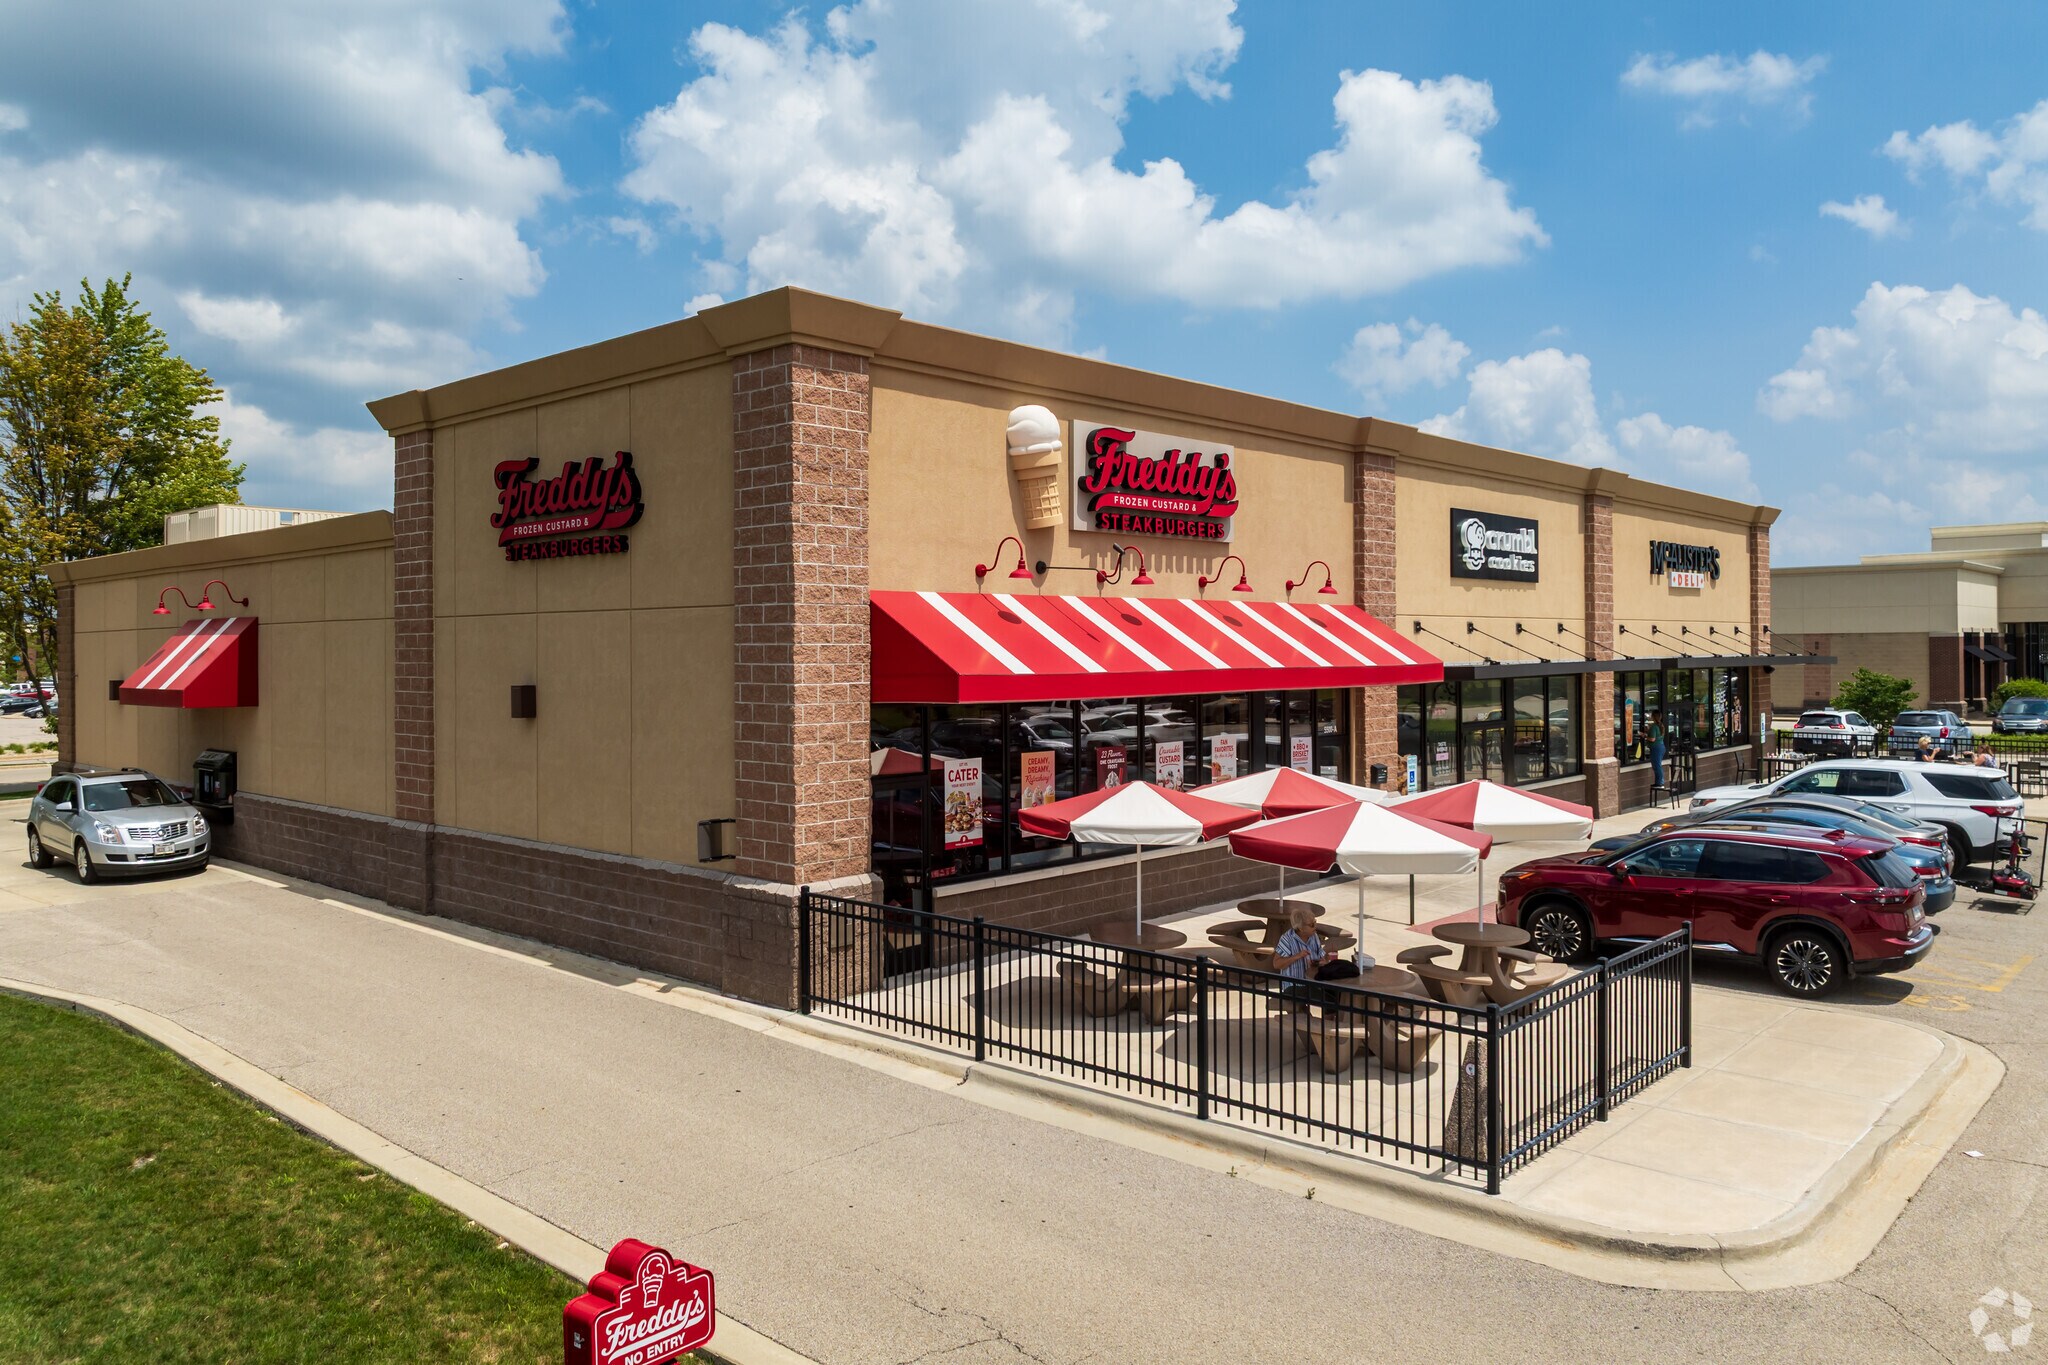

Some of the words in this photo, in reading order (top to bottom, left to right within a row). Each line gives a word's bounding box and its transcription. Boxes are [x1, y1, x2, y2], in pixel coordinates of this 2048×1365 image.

[1078, 427, 1238, 513] Freddy's
[490, 451, 643, 531] Freddy's
[1114, 496, 1149, 507] FROZEN
[1152, 499, 1189, 511] CUSTARD
[1191, 504, 1197, 512] &
[513, 523, 543, 536] FROZEN
[546, 519, 581, 532] CUSTARD
[583, 517, 589, 527] &
[1098, 513, 1225, 539] STEAKBURGERS
[505, 535, 629, 561] STEAKBURGERS
[1485, 528, 1538, 555] crumbl
[1488, 554, 1535, 573] cookies
[1677, 573, 1699, 587] DELI
[1158, 755, 1181, 764] CUSTARD
[948, 768, 979, 782] CATER
[601, 1289, 705, 1358] Freddy's
[624, 1351, 644, 1365] NO
[647, 1332, 686, 1360] ENTRY
